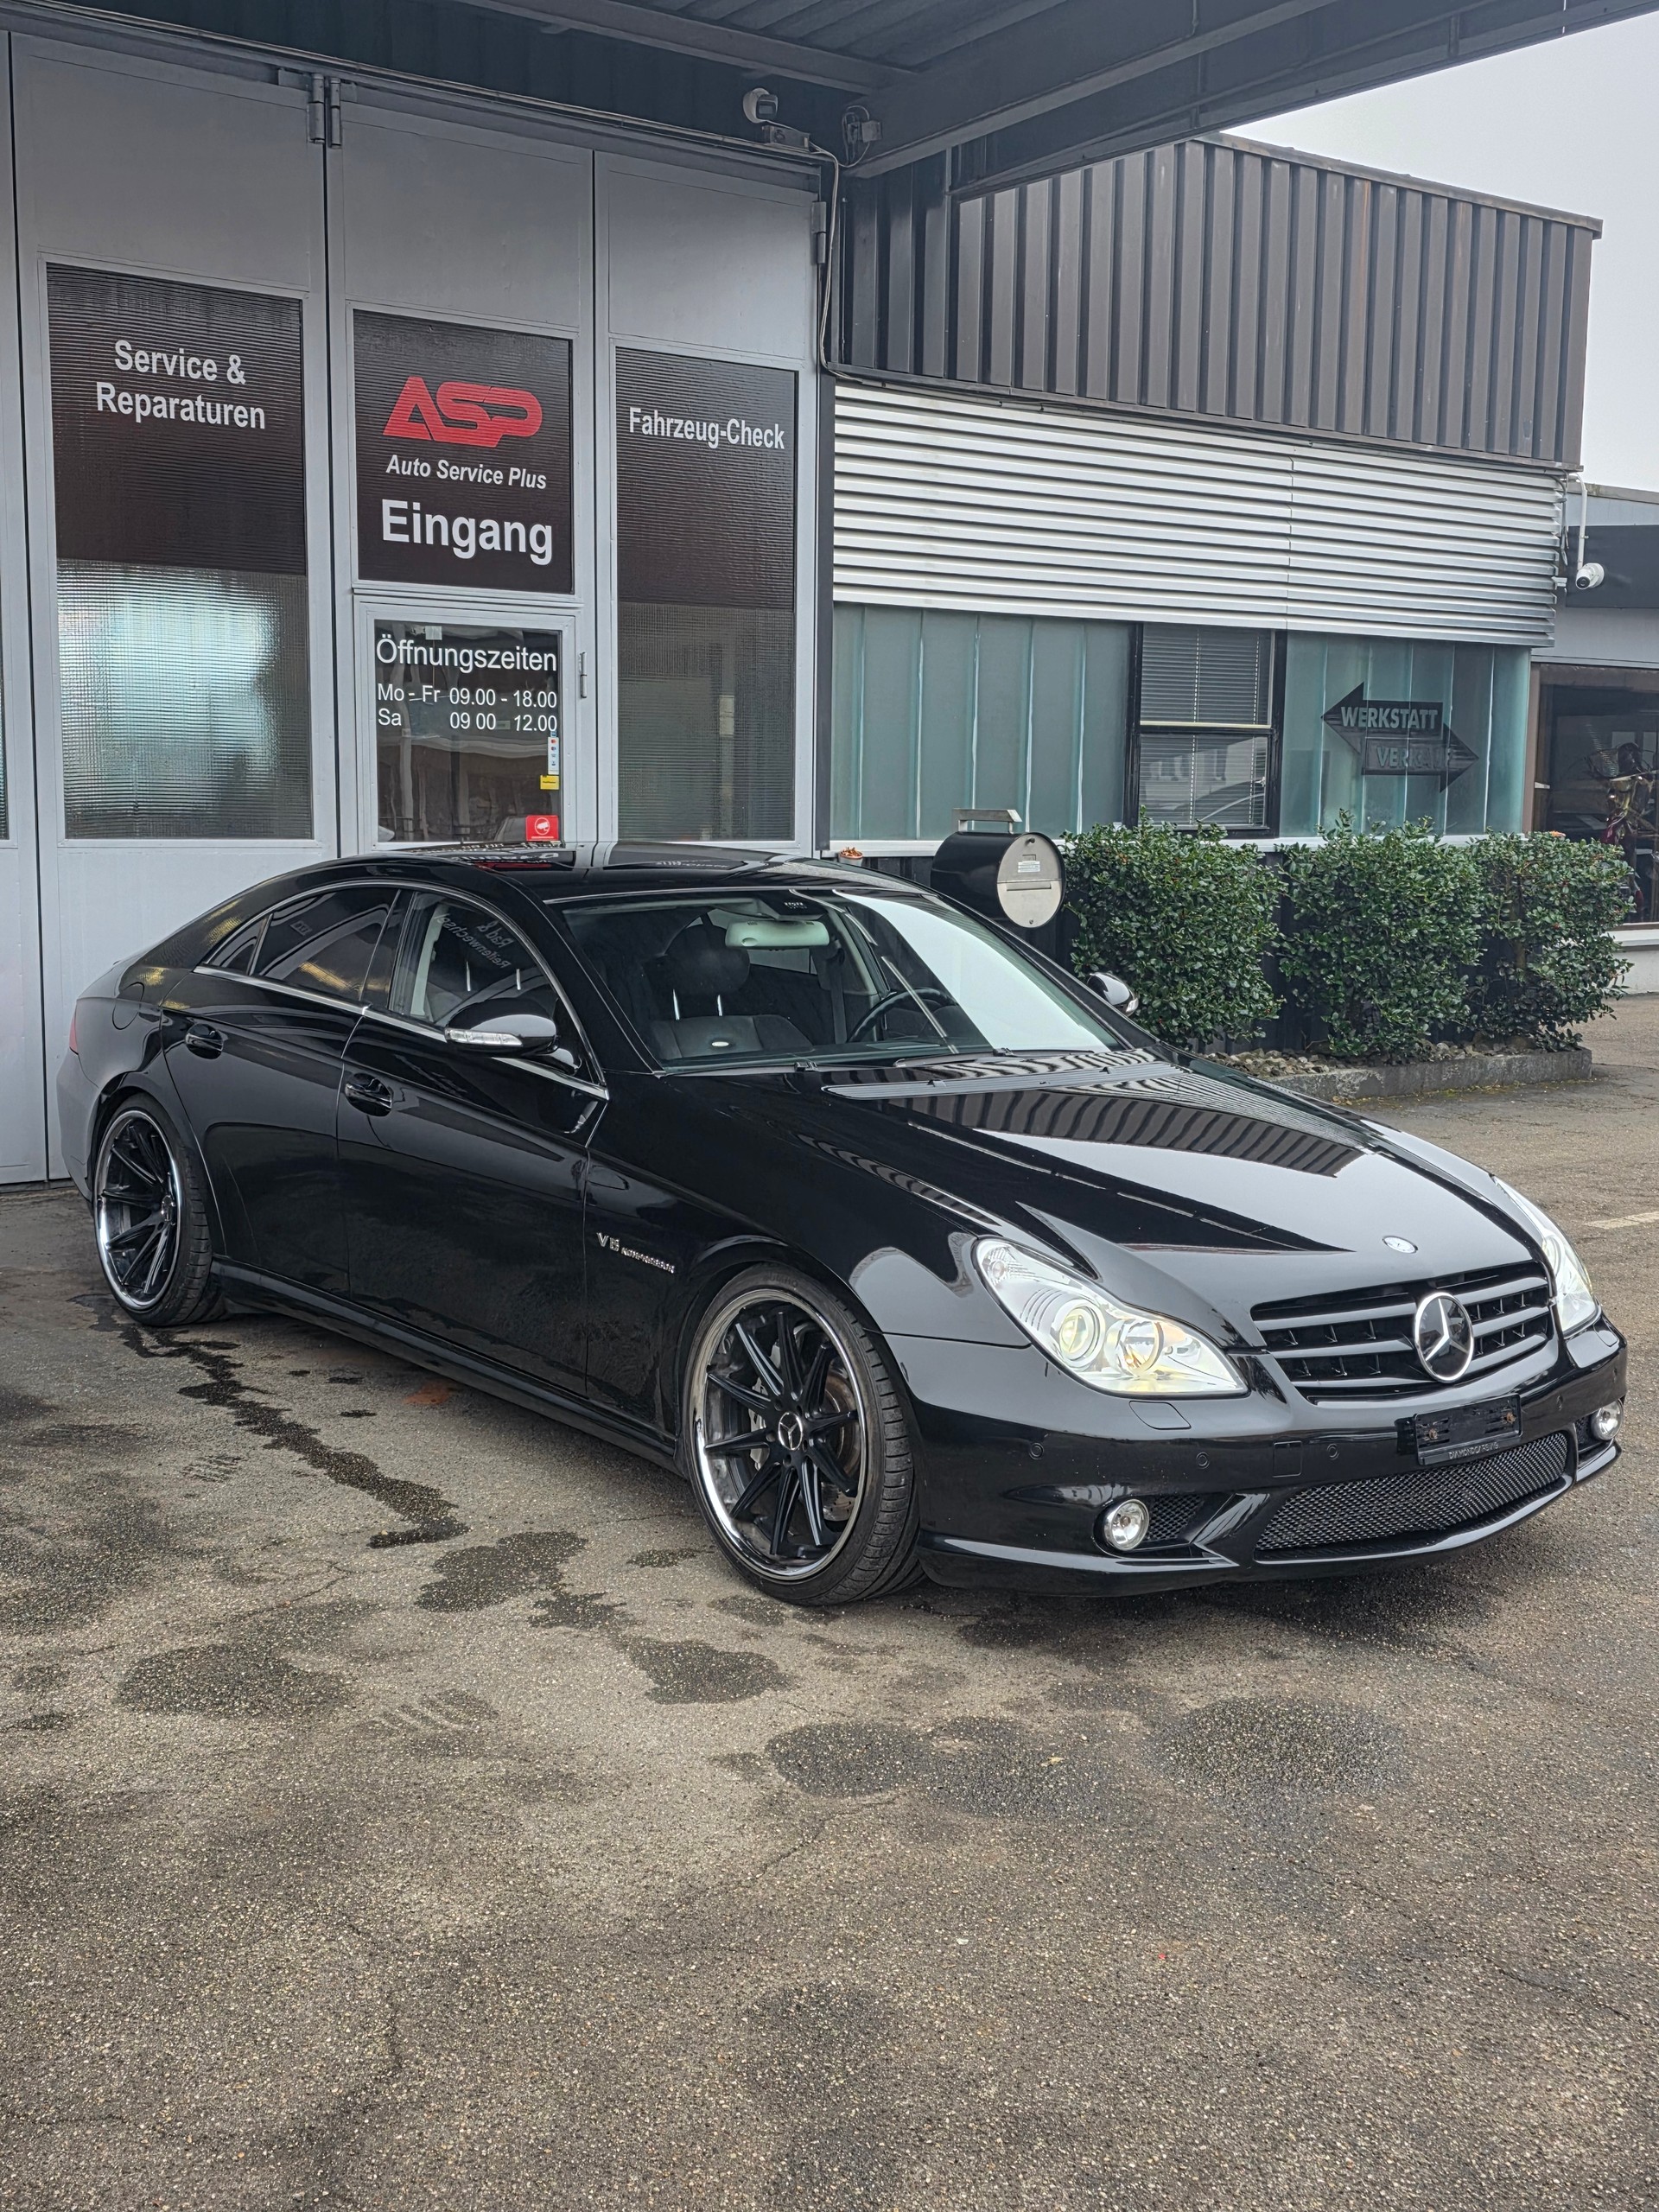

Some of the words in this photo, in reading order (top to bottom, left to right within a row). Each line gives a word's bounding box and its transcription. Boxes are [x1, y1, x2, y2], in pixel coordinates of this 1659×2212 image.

[114, 340, 218, 381] Service
[226, 354, 246, 385] &
[96, 381, 265, 429] Reparaturen
[382, 375, 543, 448] ASP
[629, 406, 785, 449] Fahrzeug-Check
[385, 454, 431, 477] Auto
[436, 460, 504, 485] Service
[508, 467, 547, 490] Plus
[382, 499, 552, 566] Eingang
[376, 633, 557, 674] Öffnungszeiten
[378, 683, 404, 702] Mo
[422, 684, 441, 703] Fr
[449, 687, 496, 707] 09.00
[513, 690, 557, 709] 18.00
[378, 708, 402, 727] Sa
[513, 714, 557, 732] 12.00
[1340, 706, 1438, 729] WERKSTATT
